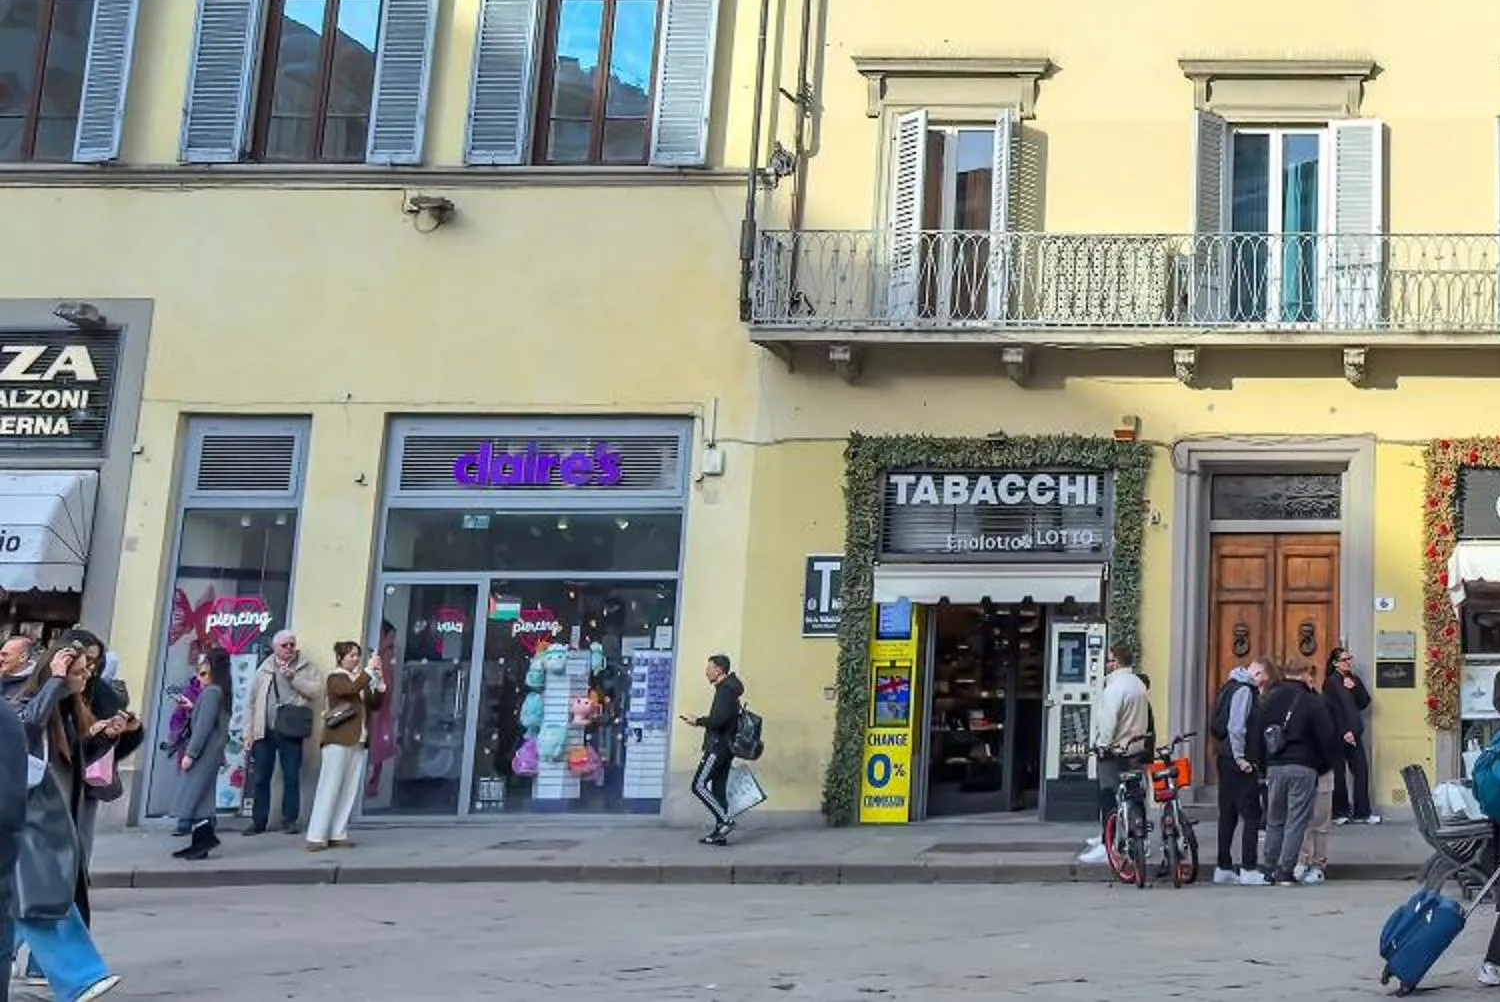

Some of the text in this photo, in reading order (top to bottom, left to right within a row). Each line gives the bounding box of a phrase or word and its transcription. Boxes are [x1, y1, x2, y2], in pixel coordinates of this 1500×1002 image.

[888, 473, 1098, 506] TABACCHI
[1036, 529, 1094, 546] LOTTO
[813, 561, 841, 613] T
[205, 609, 273, 634] piercing
